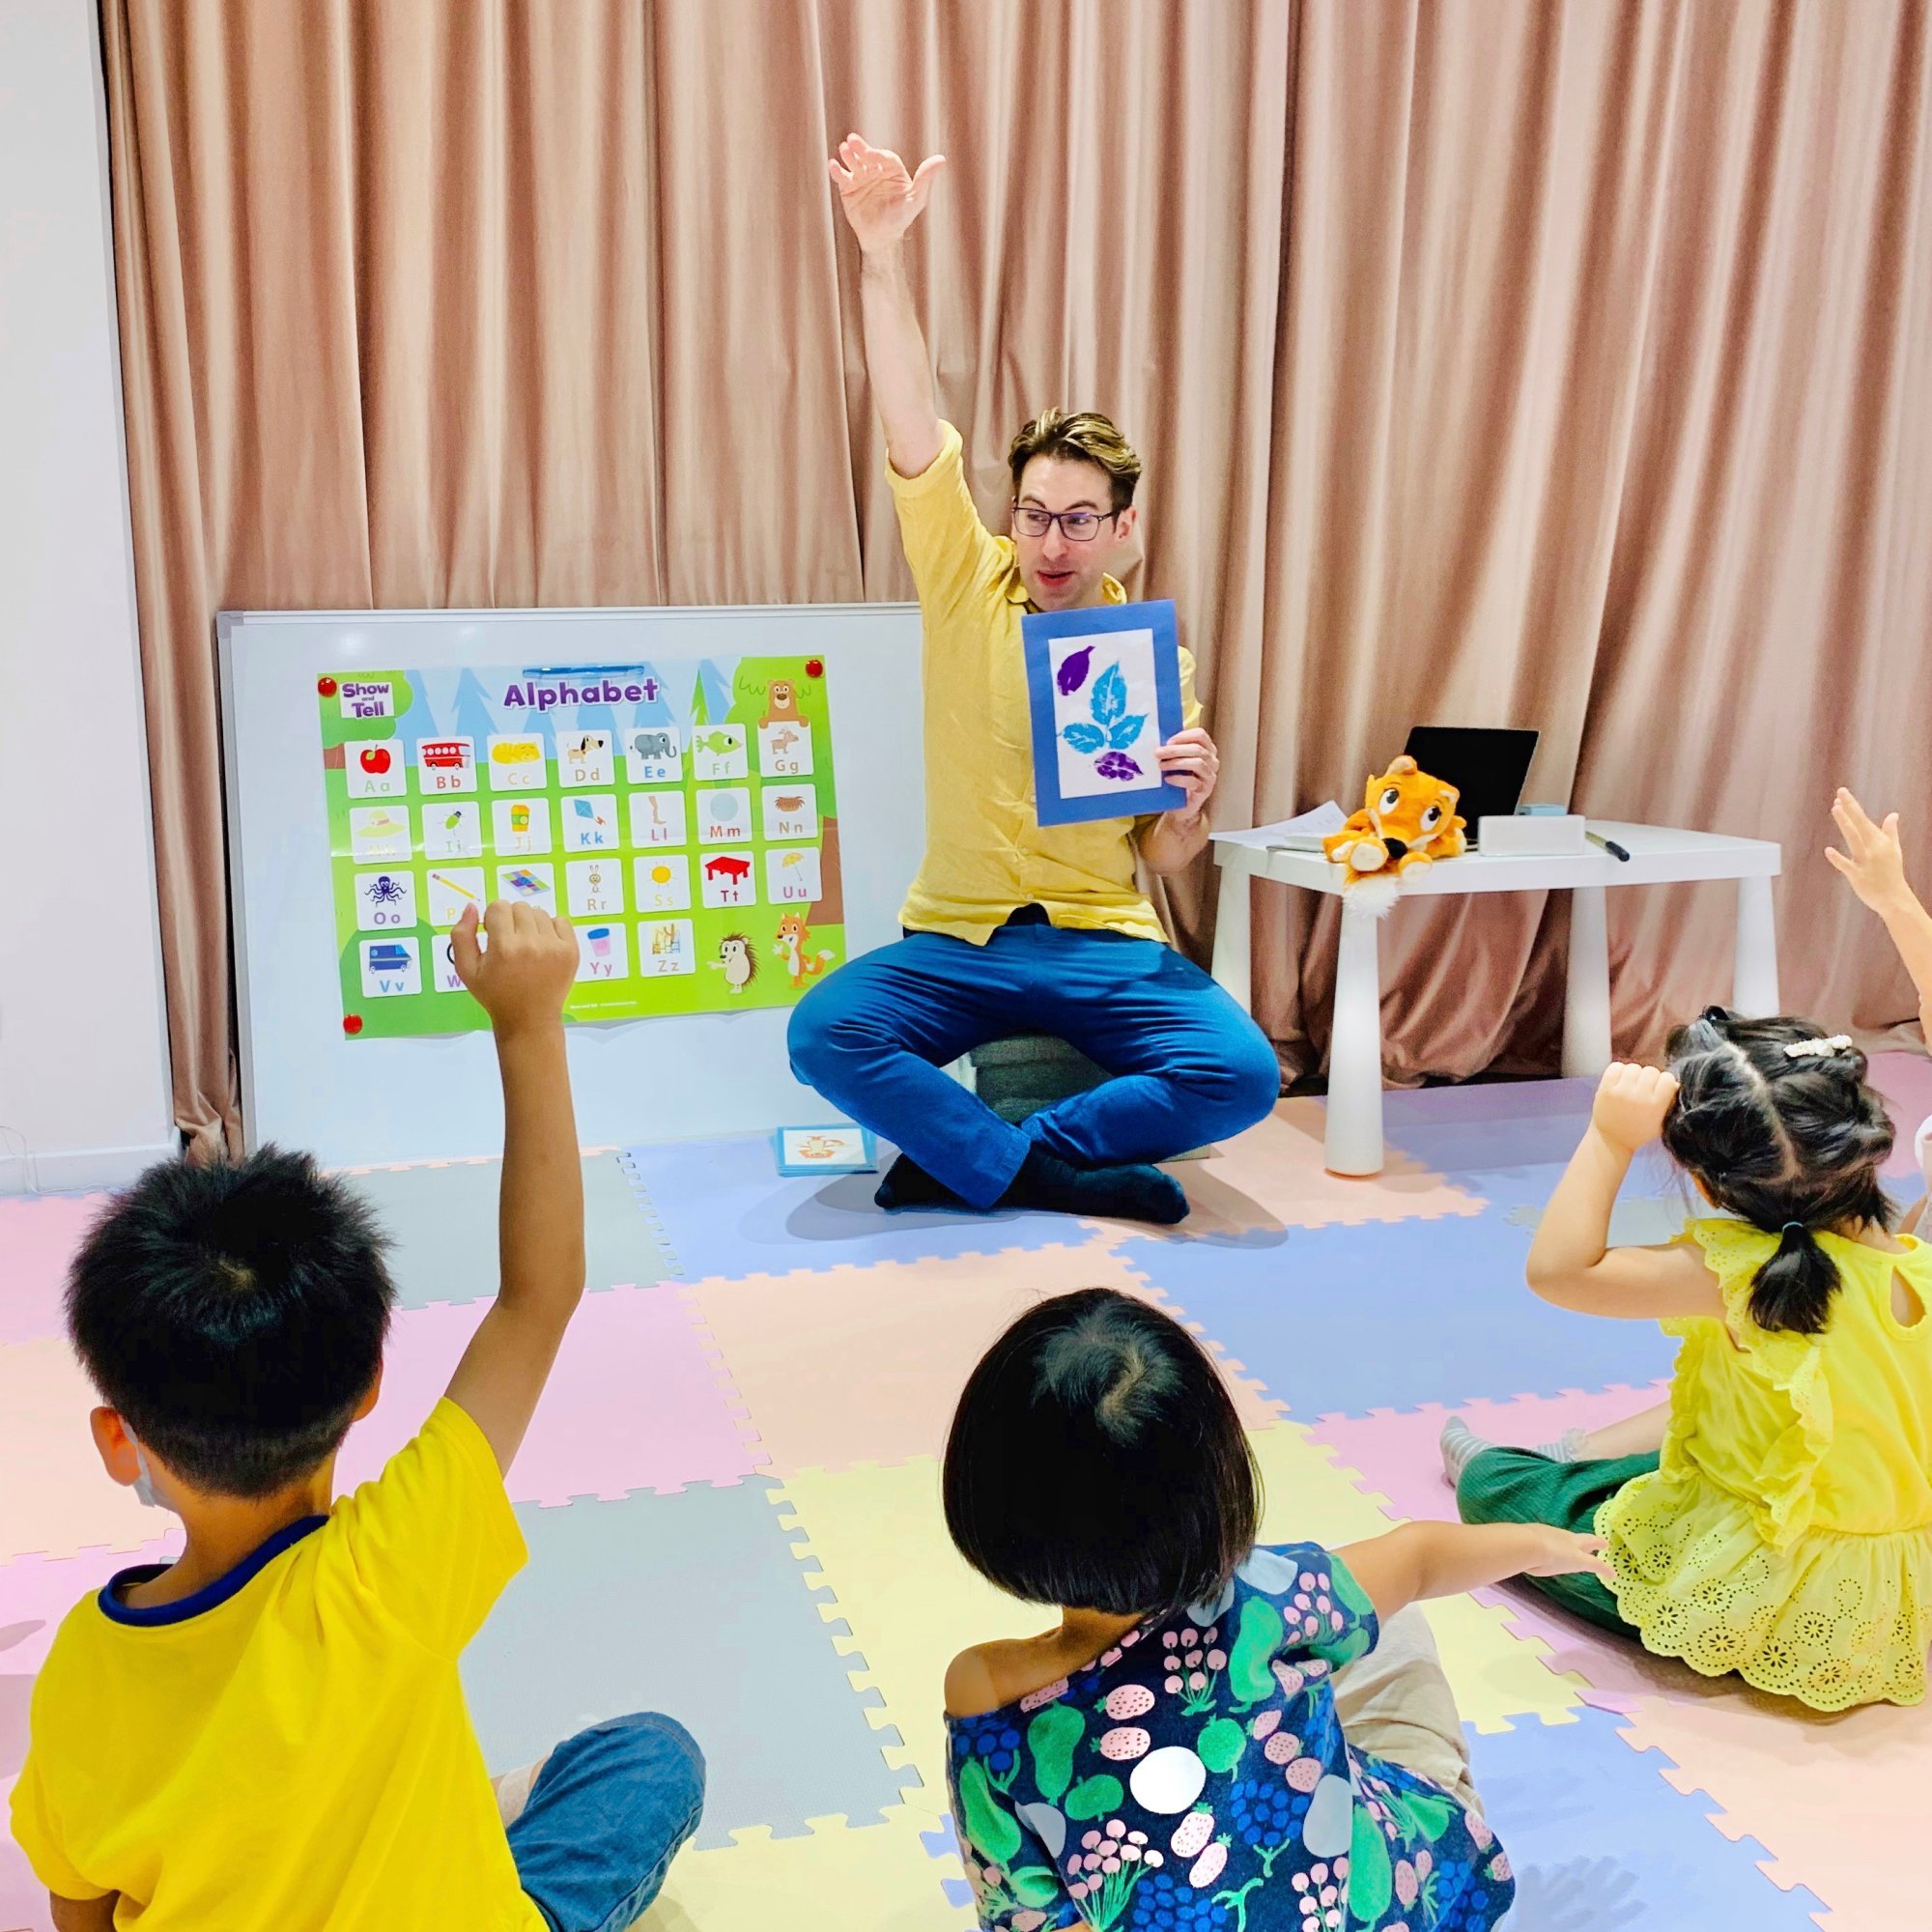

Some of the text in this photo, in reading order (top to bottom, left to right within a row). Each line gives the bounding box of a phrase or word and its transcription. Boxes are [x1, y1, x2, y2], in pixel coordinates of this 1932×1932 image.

[342, 683, 389, 697] Show
[503, 678, 658, 711] Alphabet
[352, 701, 384, 718] Tell
